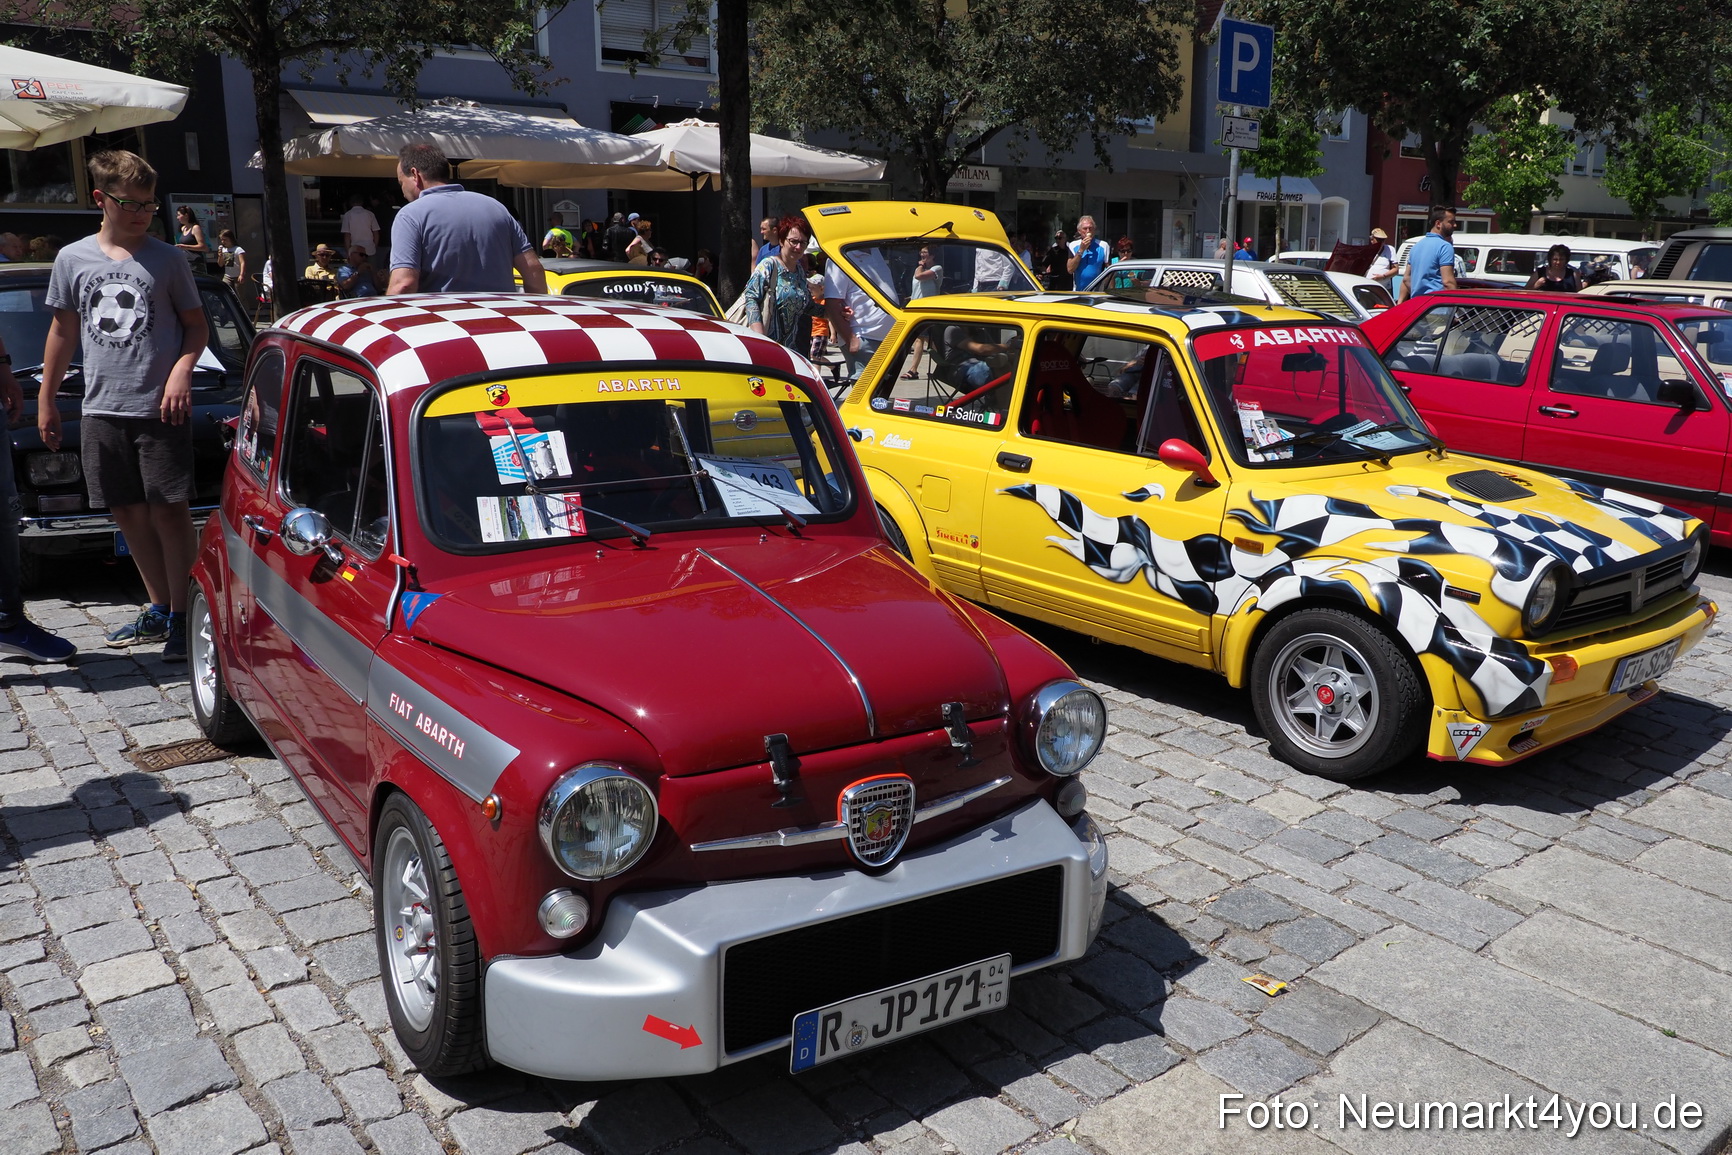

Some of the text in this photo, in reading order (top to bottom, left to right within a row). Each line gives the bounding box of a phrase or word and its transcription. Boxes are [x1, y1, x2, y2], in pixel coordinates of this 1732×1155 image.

[1231, 32, 1260, 93] P
[47, 82, 84, 91] PEPE
[1257, 191, 1303, 201] FRAUEZIMMER
[84, 276, 104, 293] DER
[107, 272, 132, 280] TUT
[108, 339, 133, 349] NUR
[1254, 328, 1353, 347] ABARTH
[597, 378, 681, 393] ABARTH
[750, 472, 784, 490] 143
[1620, 658, 1644, 688] FÜ
[389, 692, 465, 759] FIAT ABARTH
[988, 963, 1004, 977] 04
[988, 991, 1002, 1005] 10
[820, 969, 982, 1057] R JP171
[800, 1047, 809, 1060] D
